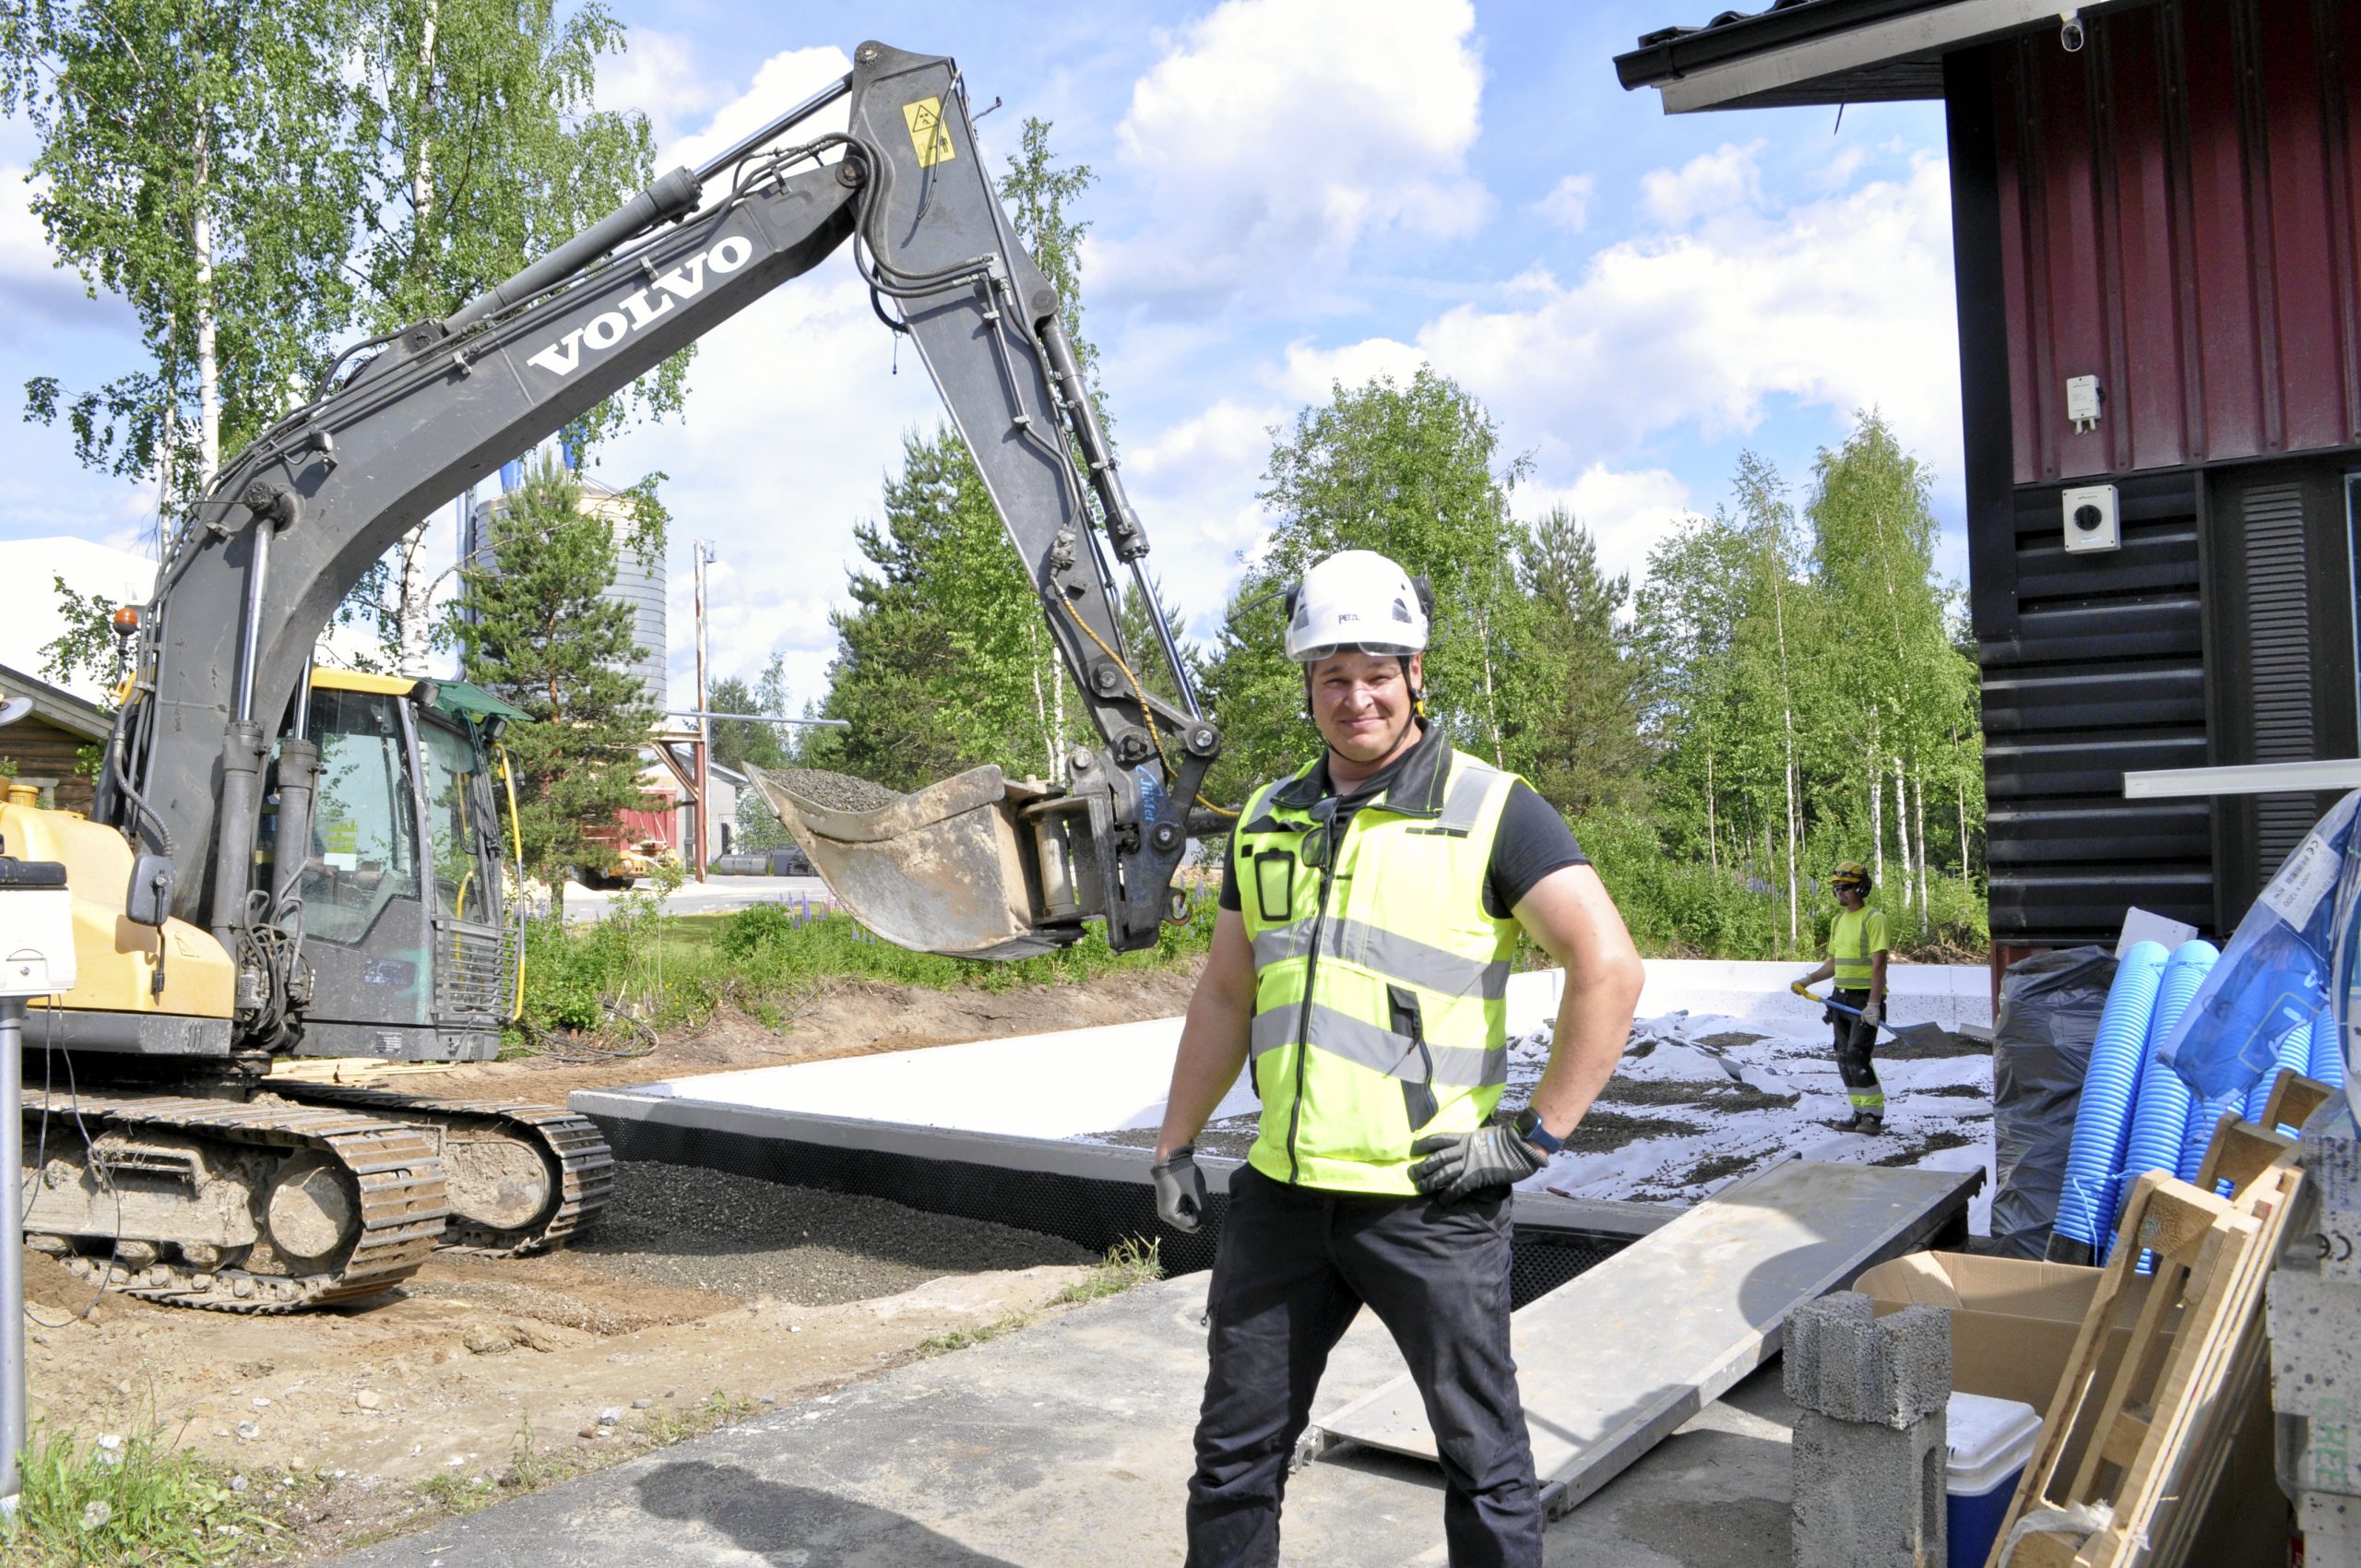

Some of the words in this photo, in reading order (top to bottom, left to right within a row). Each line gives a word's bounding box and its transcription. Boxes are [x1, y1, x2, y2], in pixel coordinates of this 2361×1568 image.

[527, 236, 753, 375] VOLVO
[2307, 840, 2319, 856] CE
[2315, 1232, 2352, 1262] CE
